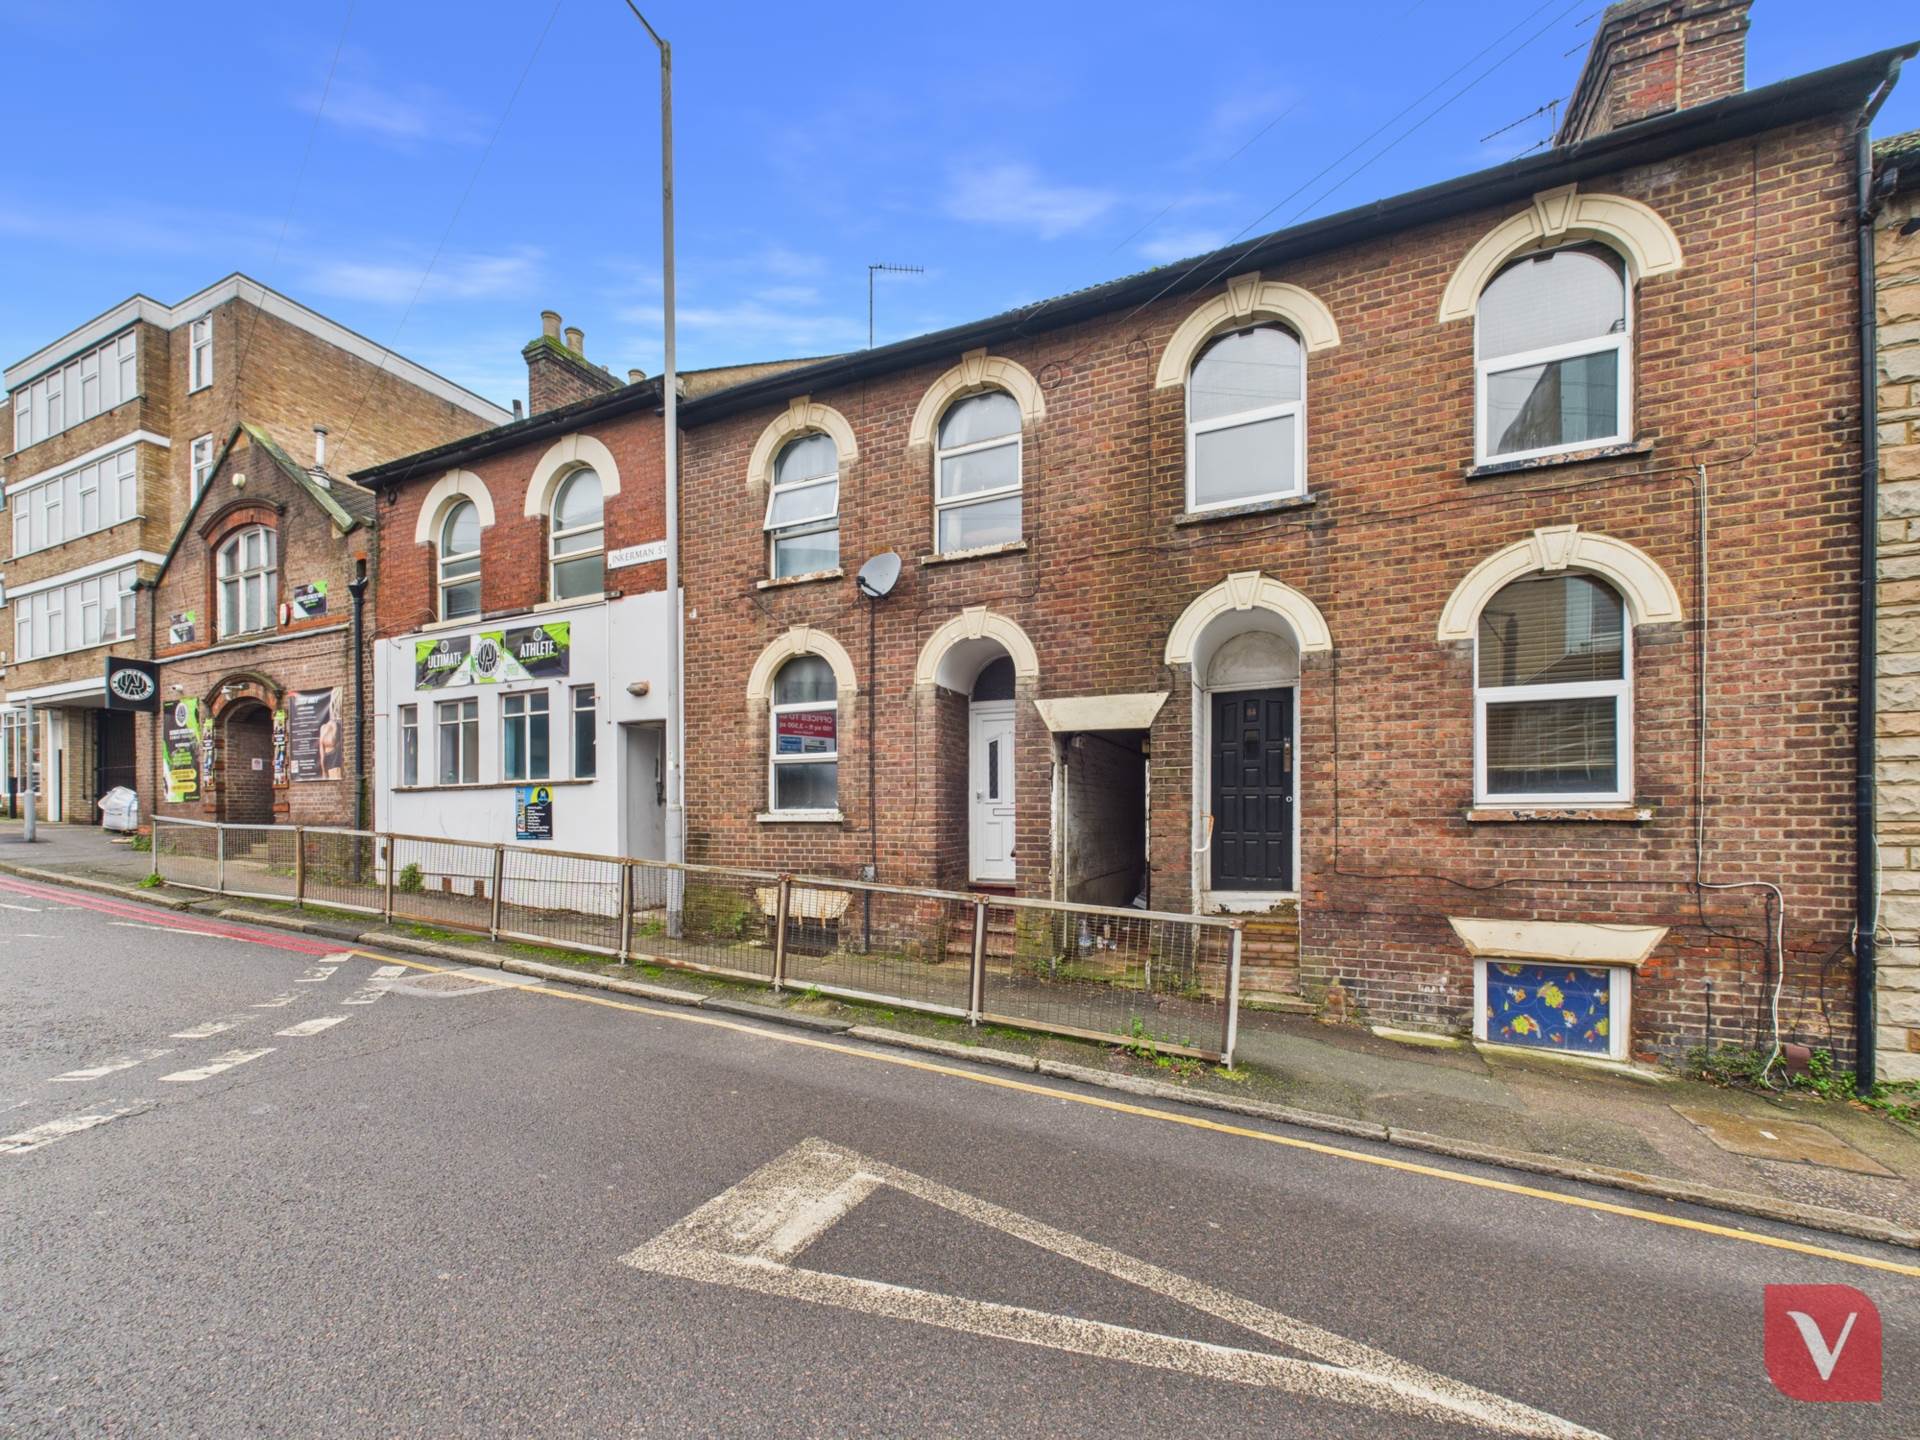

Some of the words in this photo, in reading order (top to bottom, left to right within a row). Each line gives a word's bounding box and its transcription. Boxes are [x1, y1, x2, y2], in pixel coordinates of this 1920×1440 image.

[612, 547, 655, 563] INKERMAN
[520, 640, 554, 658] ATHLETE
[428, 651, 462, 669] ULTIMATE
